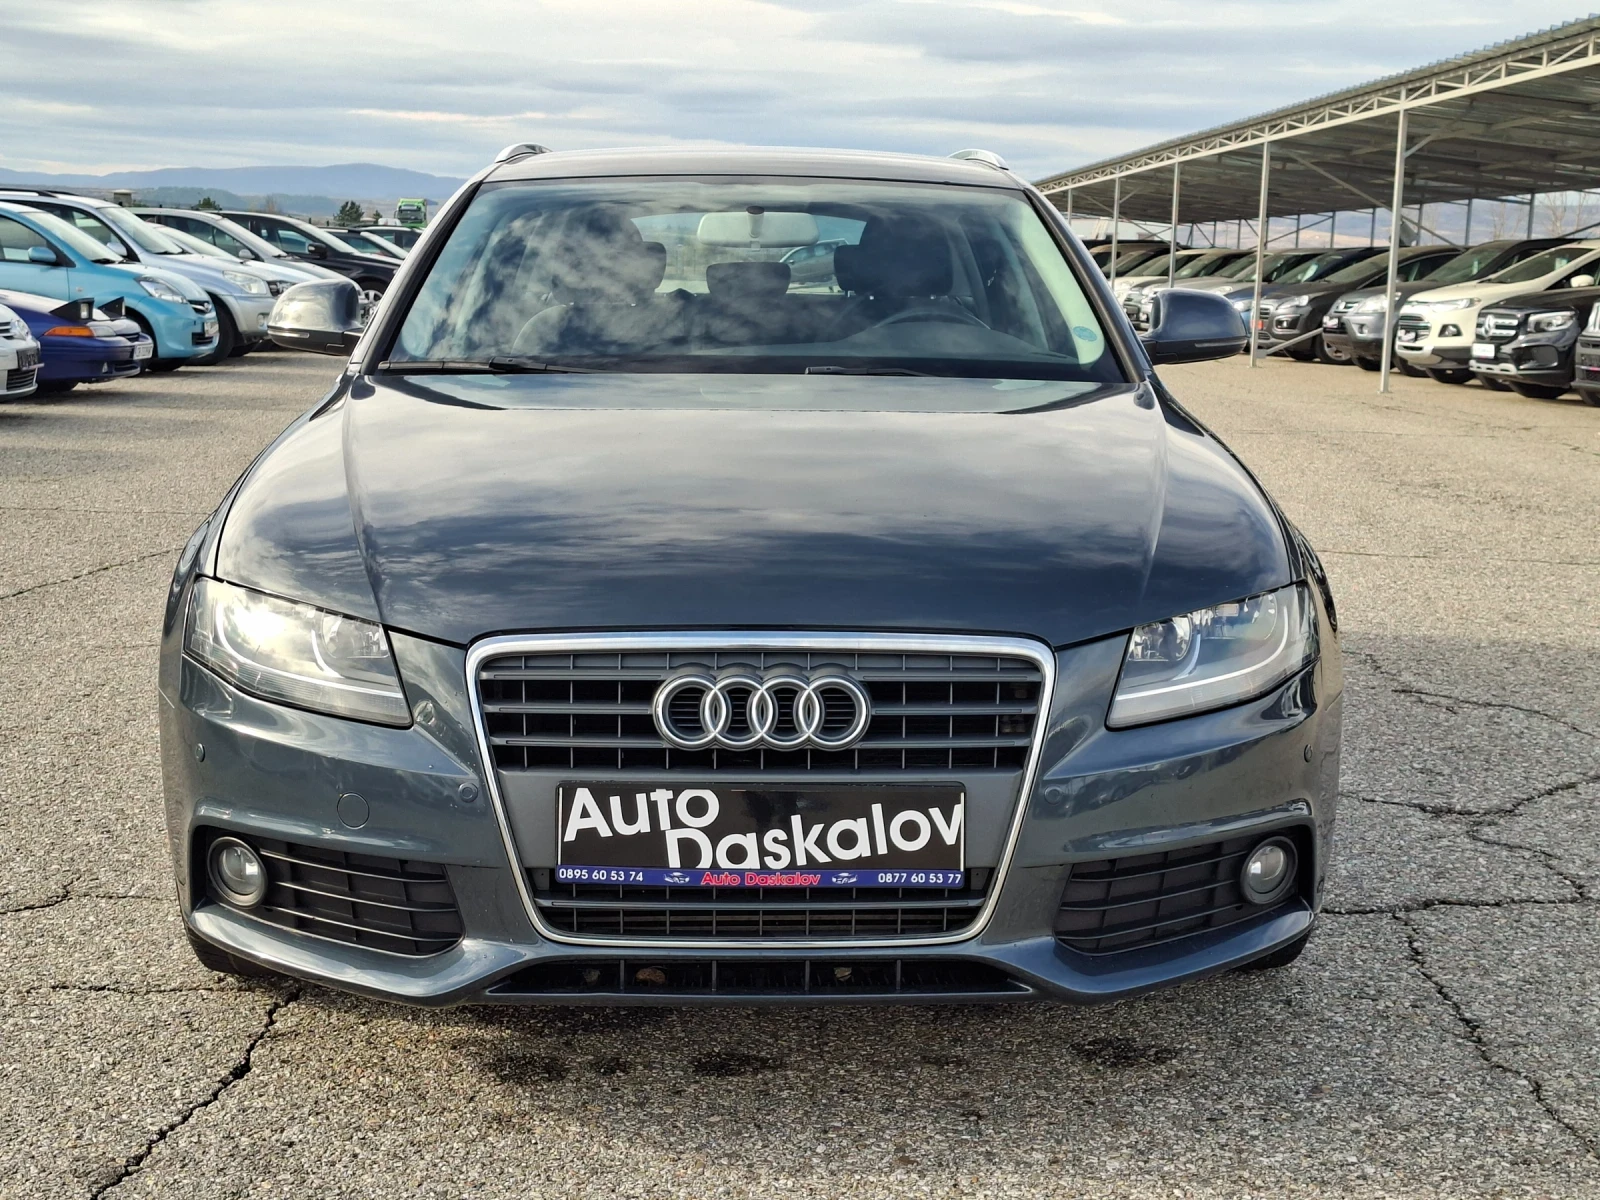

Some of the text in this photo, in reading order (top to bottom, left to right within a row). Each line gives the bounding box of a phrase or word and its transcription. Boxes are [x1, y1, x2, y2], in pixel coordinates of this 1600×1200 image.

[563, 787, 720, 842] Auto
[665, 803, 962, 870] Daskalov
[559, 868, 643, 882] 0895 60 53 74
[700, 871, 821, 886] Auto Daskalov
[878, 872, 962, 884] 0877 60 53 77
